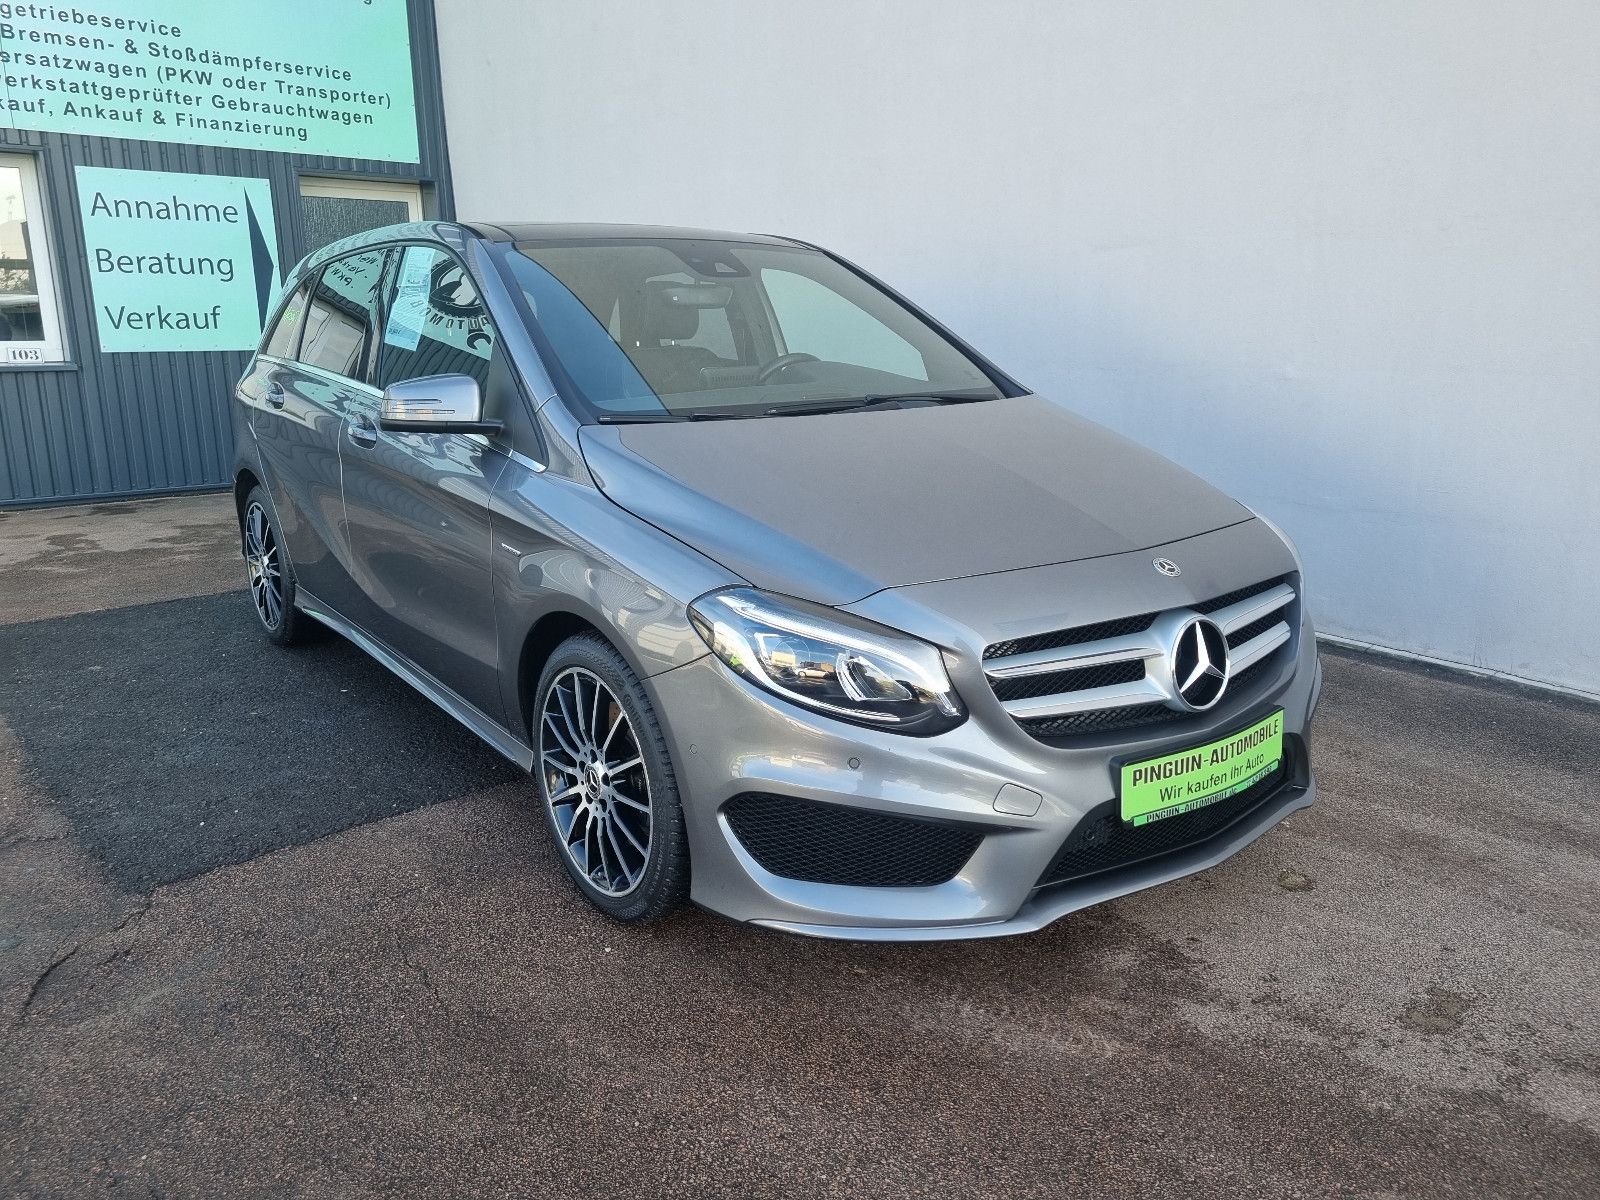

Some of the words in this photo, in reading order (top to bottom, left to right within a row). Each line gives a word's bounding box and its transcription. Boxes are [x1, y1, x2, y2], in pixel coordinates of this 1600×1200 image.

[0, 3, 181, 37] getriebeservice
[0, 23, 114, 50] Bremsen-
[124, 39, 138, 54] &
[148, 42, 352, 81] Stoßdämpferservice
[0, 51, 147, 78] ersatzwagen
[157, 66, 213, 86] (PKW
[222, 76, 266, 92] oder
[275, 80, 391, 109] Transporter)
[0, 74, 202, 107] erkstattgeprüfter
[212, 94, 373, 125] Gebrauchtwagen
[63, 101, 143, 123] Ankauf
[153, 110, 166, 125] &
[176, 112, 308, 141] Finanzierung
[91, 192, 239, 223] Annahme
[95, 248, 234, 282] Beratung
[104, 304, 221, 330] Verkauf
[12, 349, 39, 360] 103
[1132, 719, 1278, 787] PINGUIN-AUTOMOBILE
[1160, 785, 1183, 802] Wir
[1187, 773, 1227, 795] kaufen
[1230, 764, 1244, 780] Ihr
[1245, 752, 1264, 772] Auto
